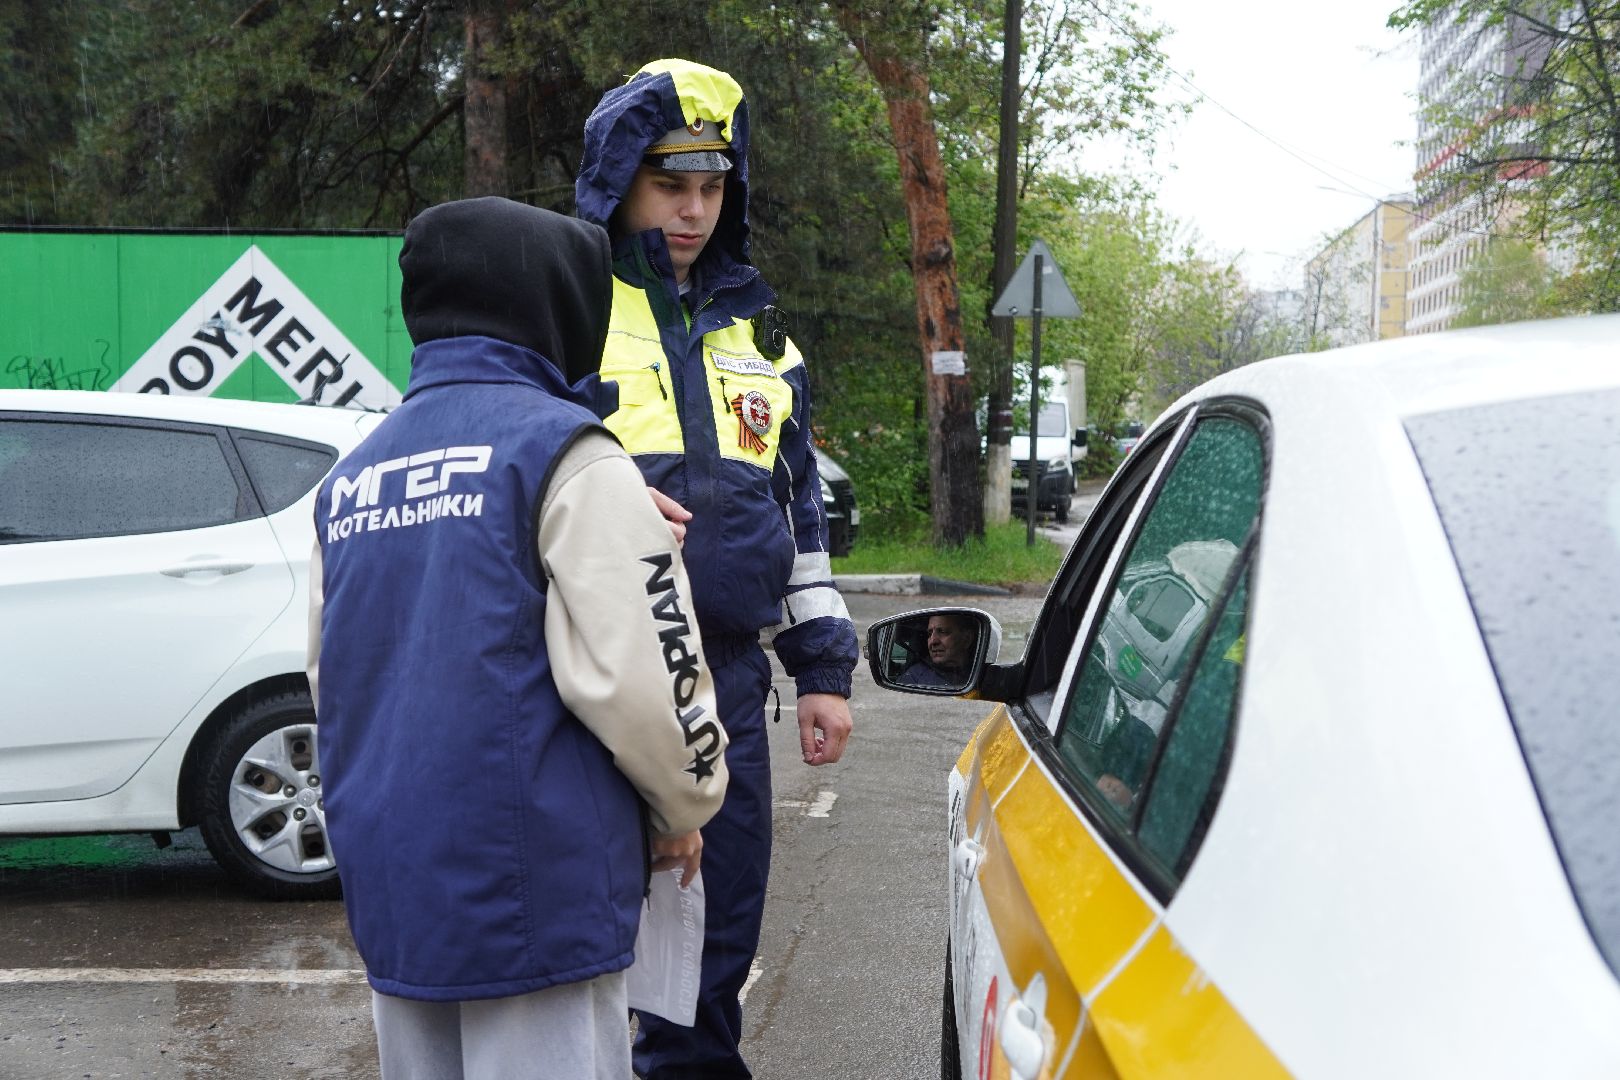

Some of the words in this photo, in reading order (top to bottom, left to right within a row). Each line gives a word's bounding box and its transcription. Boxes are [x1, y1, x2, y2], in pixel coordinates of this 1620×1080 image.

[738, 361, 774, 374] ГИБДД
[329, 446, 493, 518] МГЕР
[328, 494, 483, 543] КОТЕЛЬНИКИ
[638, 551, 721, 757] UTOPIAN
